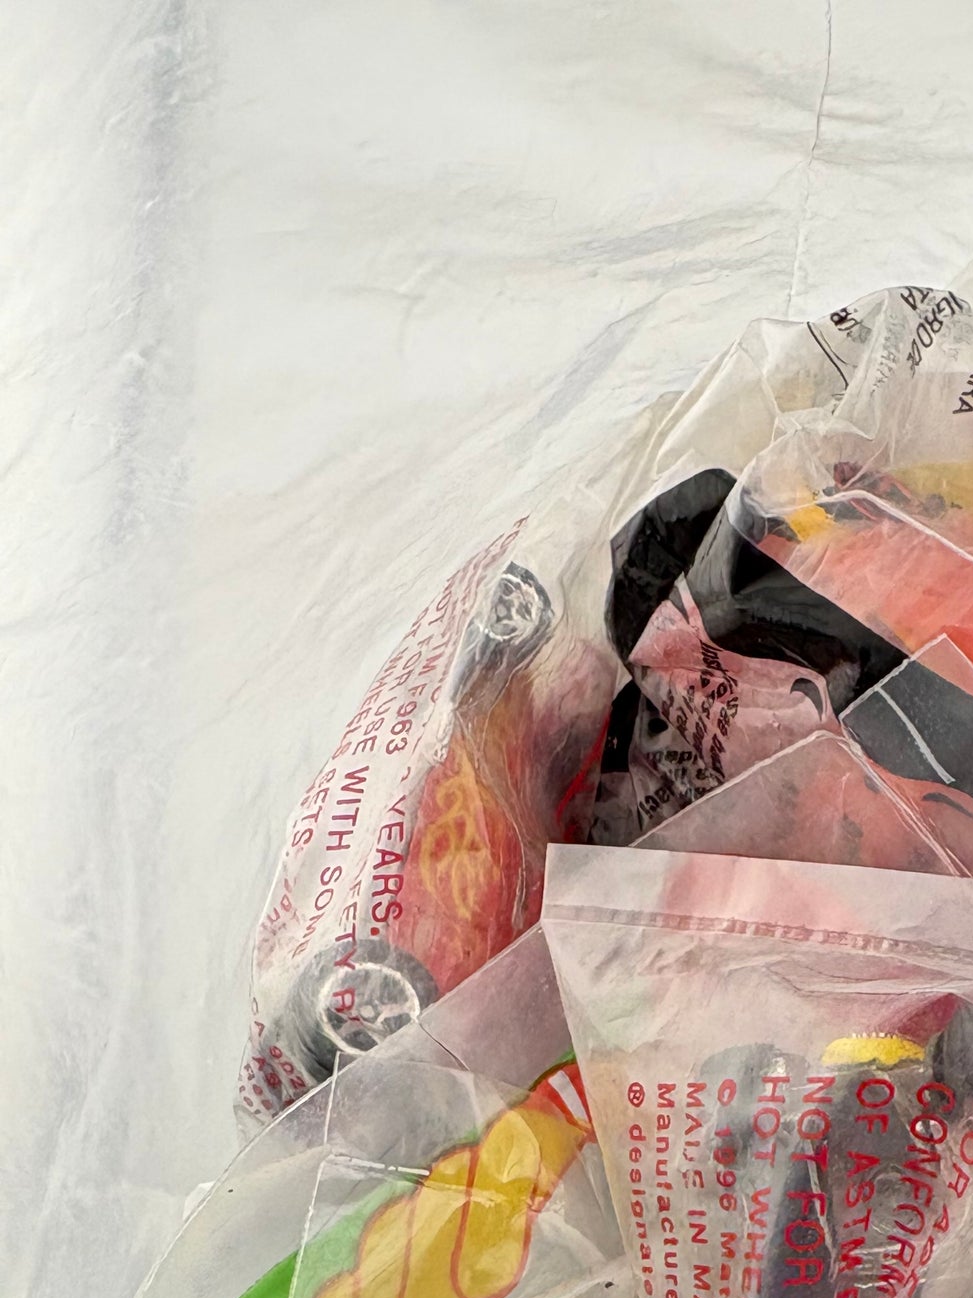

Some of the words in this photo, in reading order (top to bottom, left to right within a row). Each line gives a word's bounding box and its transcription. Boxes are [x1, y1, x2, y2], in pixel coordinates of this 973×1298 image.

[326, 765, 370, 851] WITH
[370, 794, 406, 937] YEARS.
[753, 1076, 791, 1169] HOT
[791, 1076, 836, 1173] NOT
[855, 1077, 896, 1135] OF
[713, 1126, 738, 1213] 1996
[838, 1150, 881, 1273] ASTM
[686, 1209, 709, 1245] IN
[784, 1189, 827, 1289] FOR
